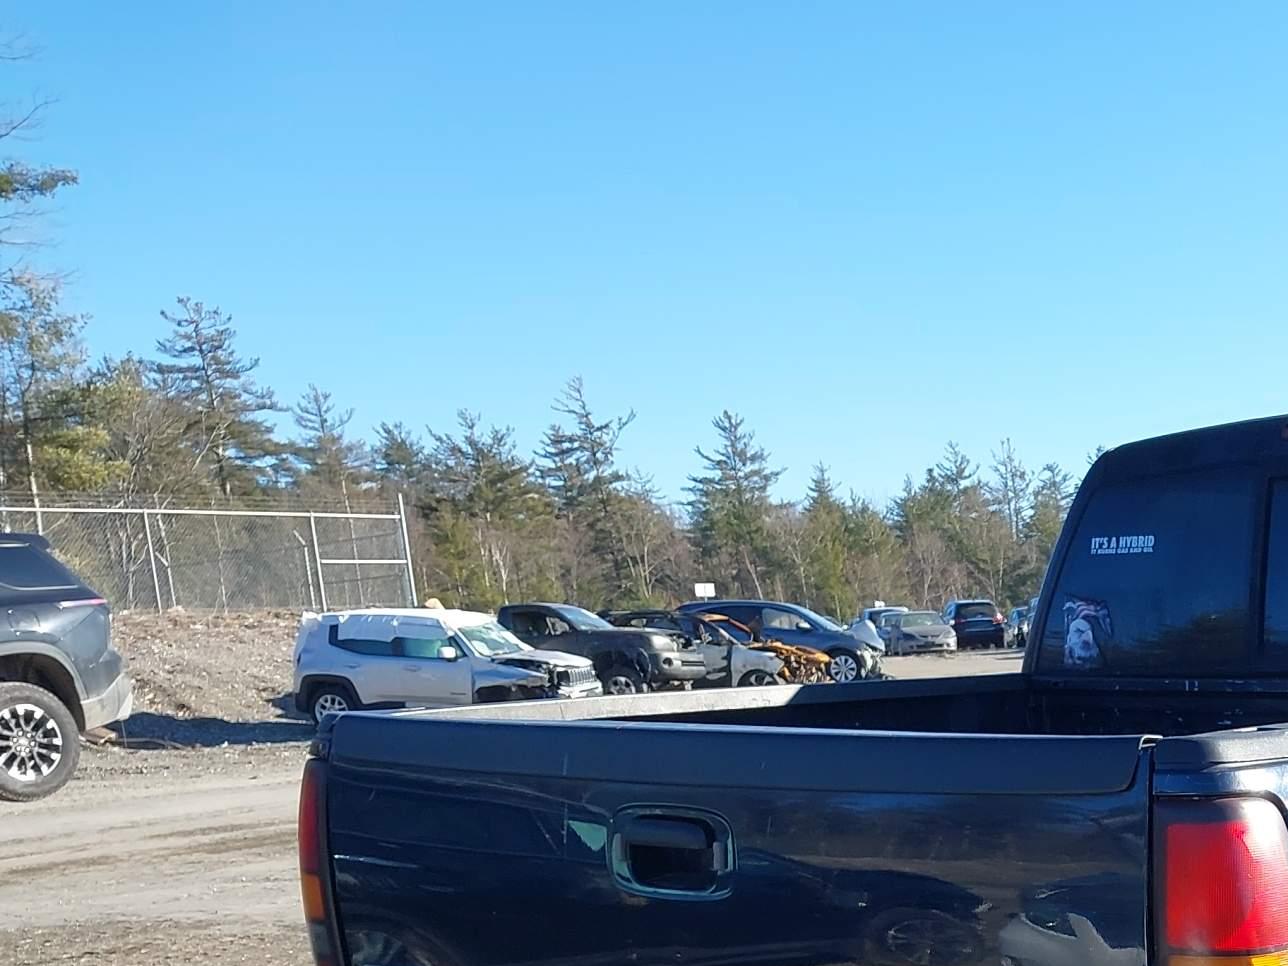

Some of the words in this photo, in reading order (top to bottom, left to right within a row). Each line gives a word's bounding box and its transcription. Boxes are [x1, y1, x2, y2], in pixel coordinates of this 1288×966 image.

[1091, 537, 1108, 549] IT'S
[1110, 536, 1117, 549] A
[1119, 535, 1155, 548] HYBRID
